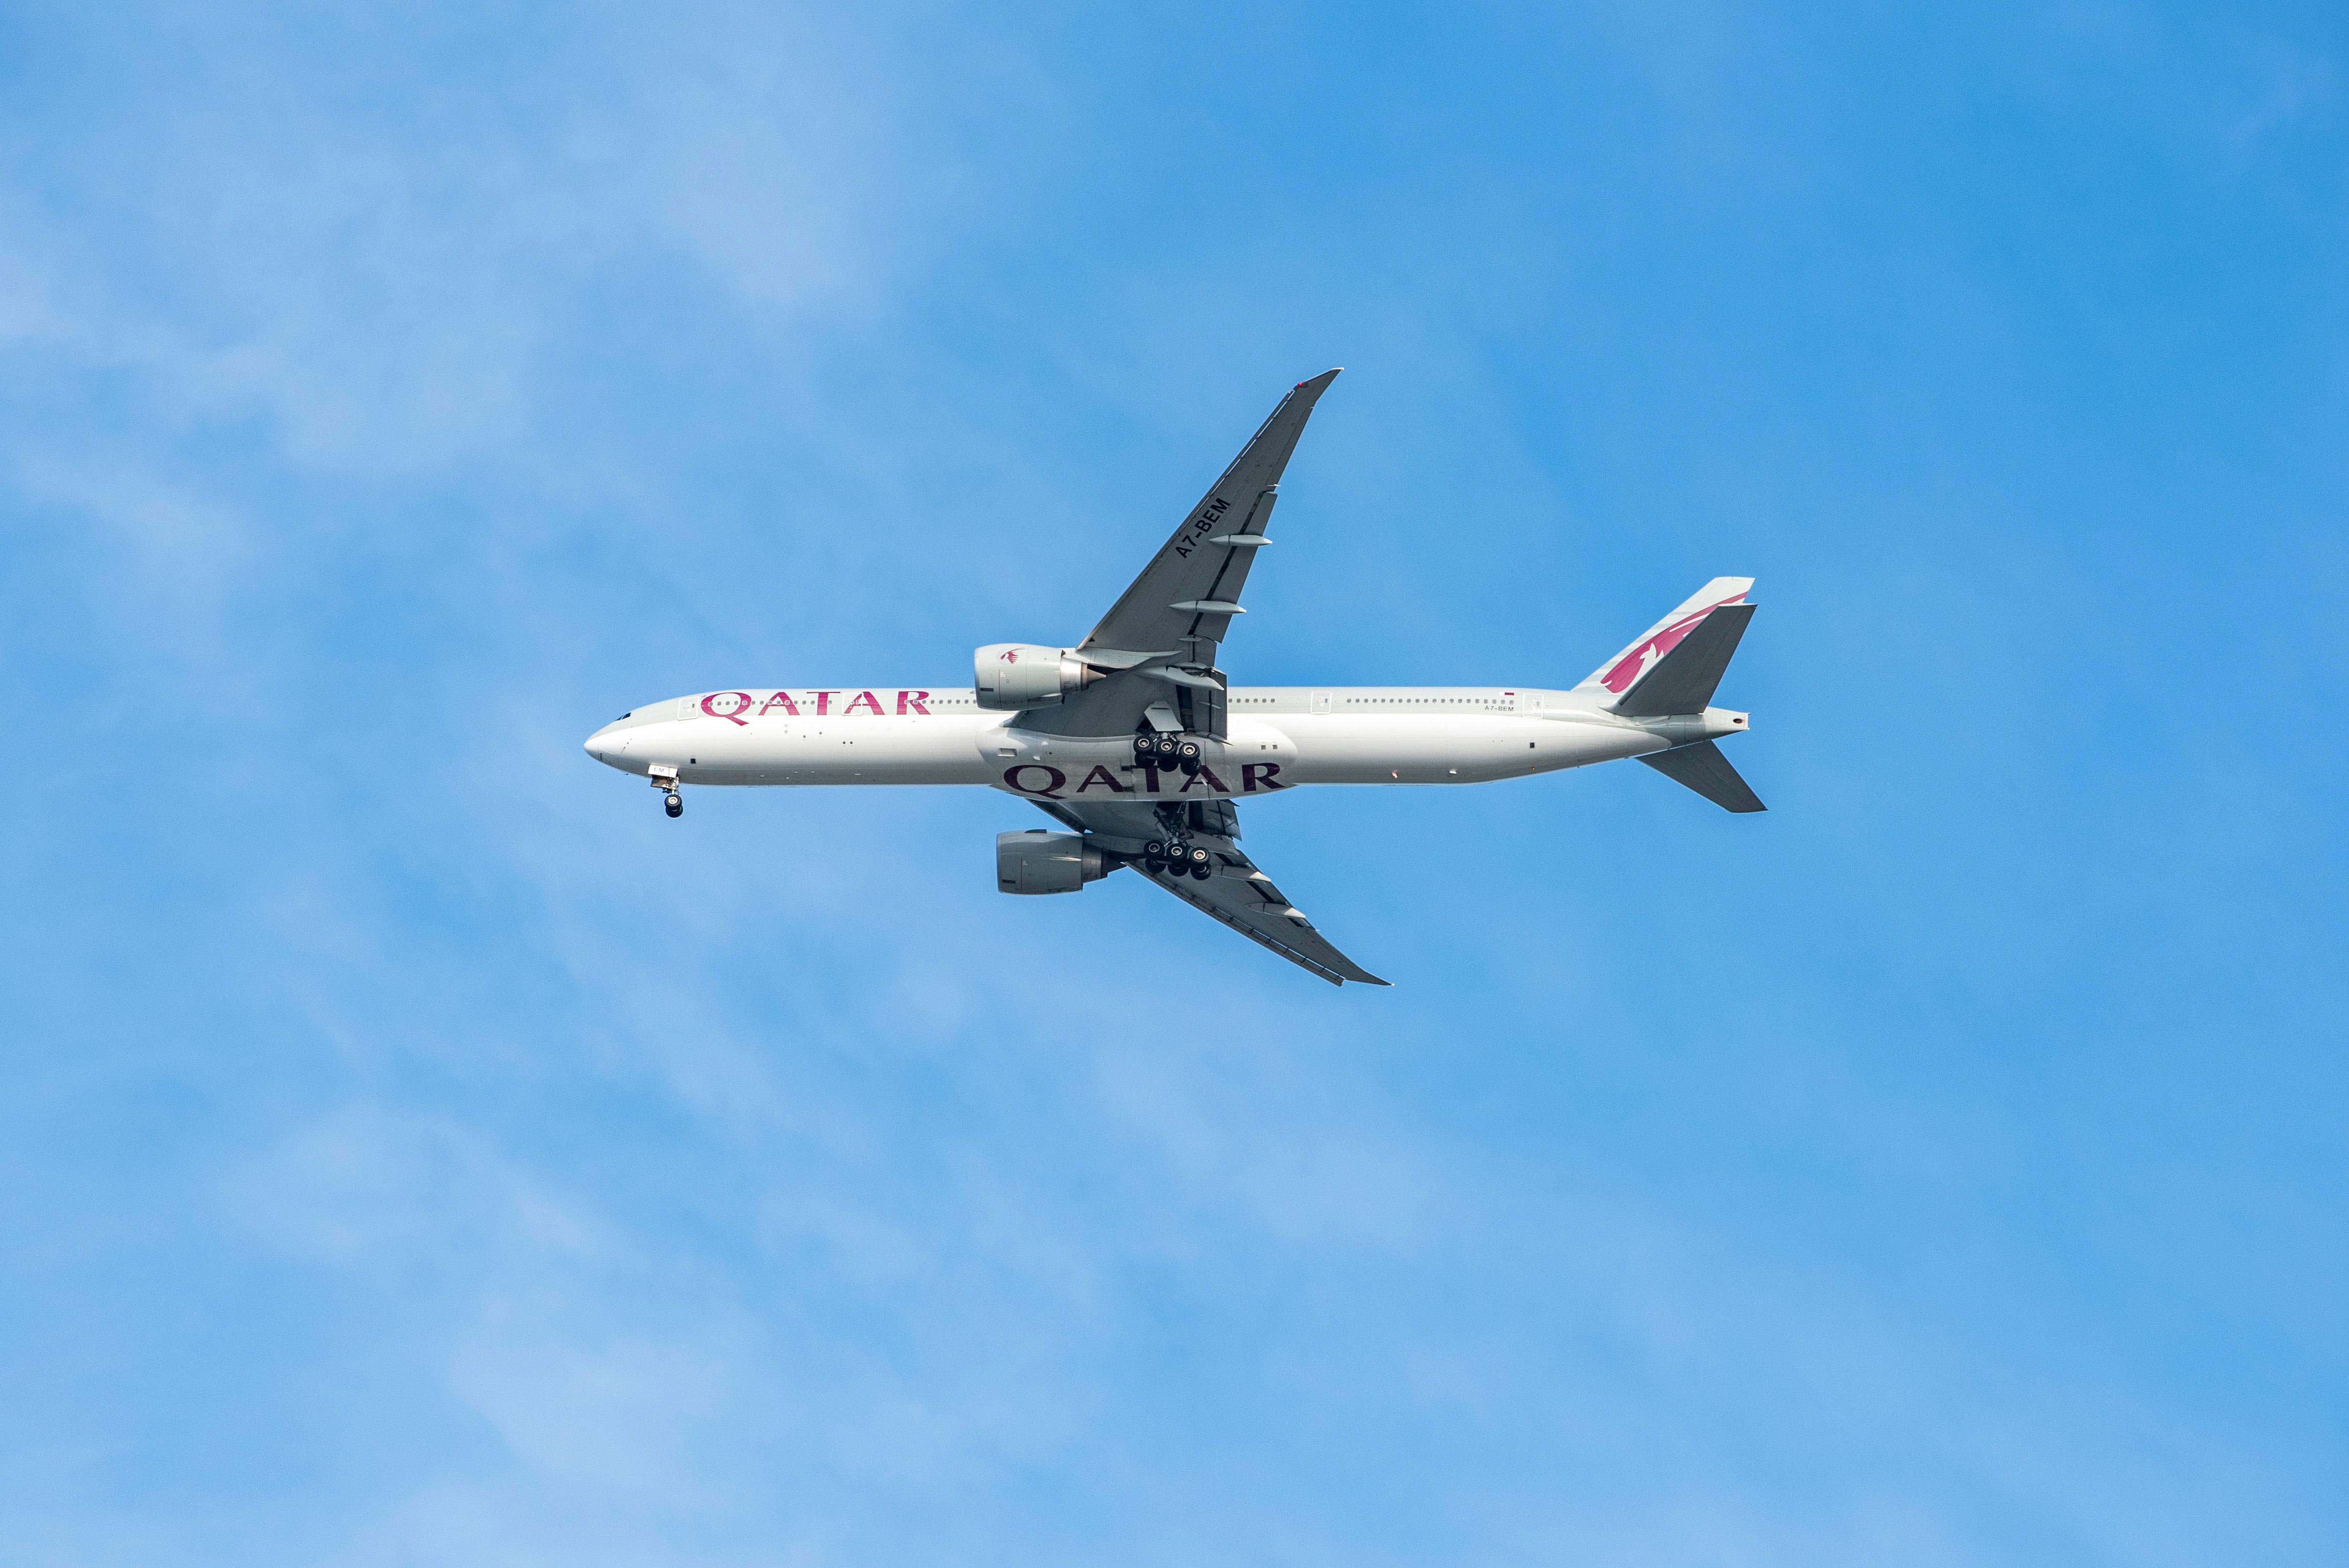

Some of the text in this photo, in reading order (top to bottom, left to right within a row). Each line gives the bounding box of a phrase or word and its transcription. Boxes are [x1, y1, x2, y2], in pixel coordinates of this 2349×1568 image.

[1175, 497, 1230, 559] A7-BEM
[701, 691, 931, 726] QATAR
[1003, 762, 1286, 800] QATAR
